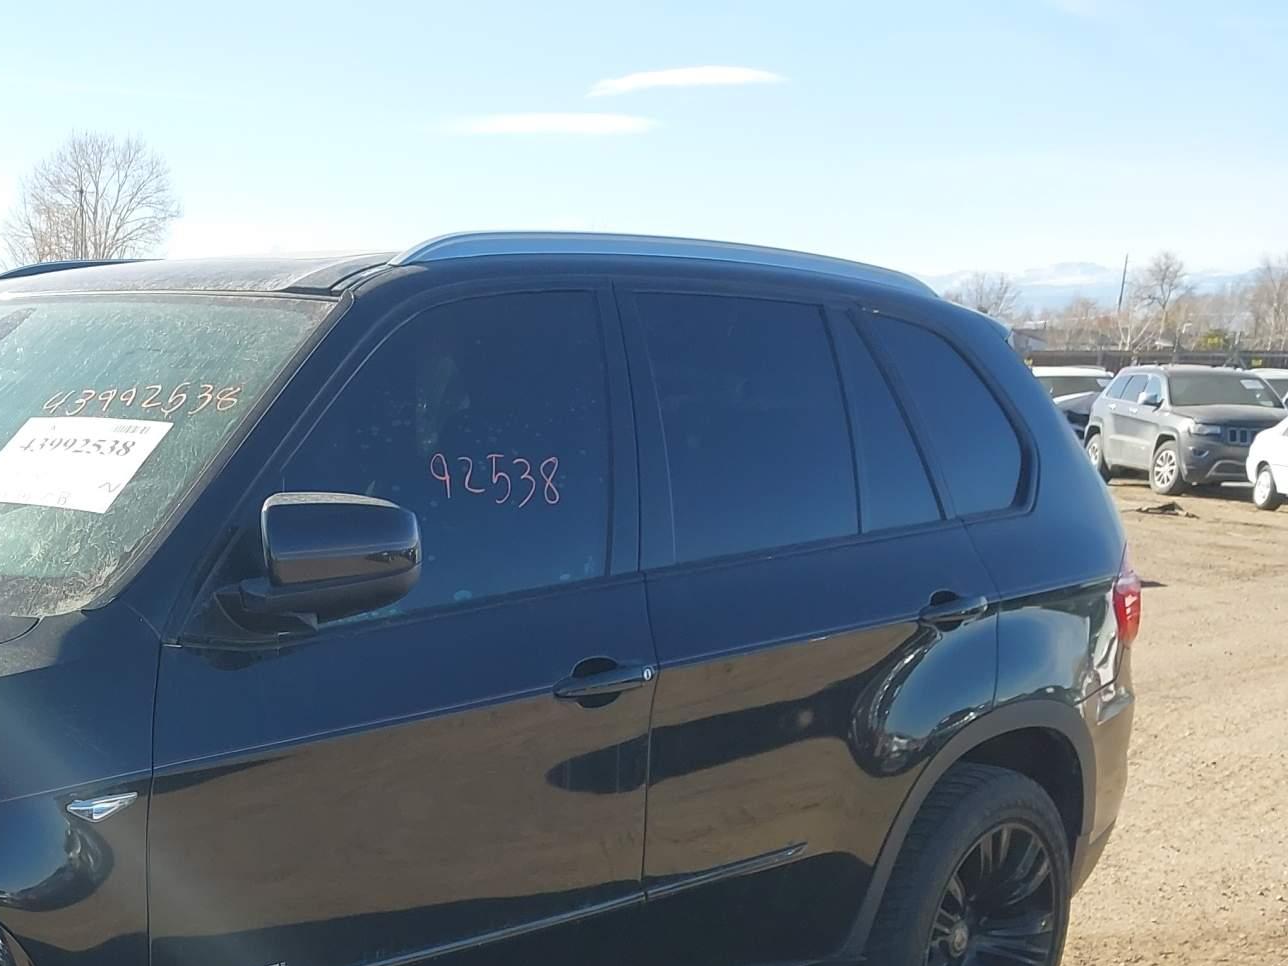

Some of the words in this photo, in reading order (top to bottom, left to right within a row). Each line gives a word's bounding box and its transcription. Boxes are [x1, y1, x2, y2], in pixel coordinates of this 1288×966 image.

[43, 382, 241, 416] 43992538
[19, 437, 137, 457] 43992538
[430, 453, 560, 508] 92538
